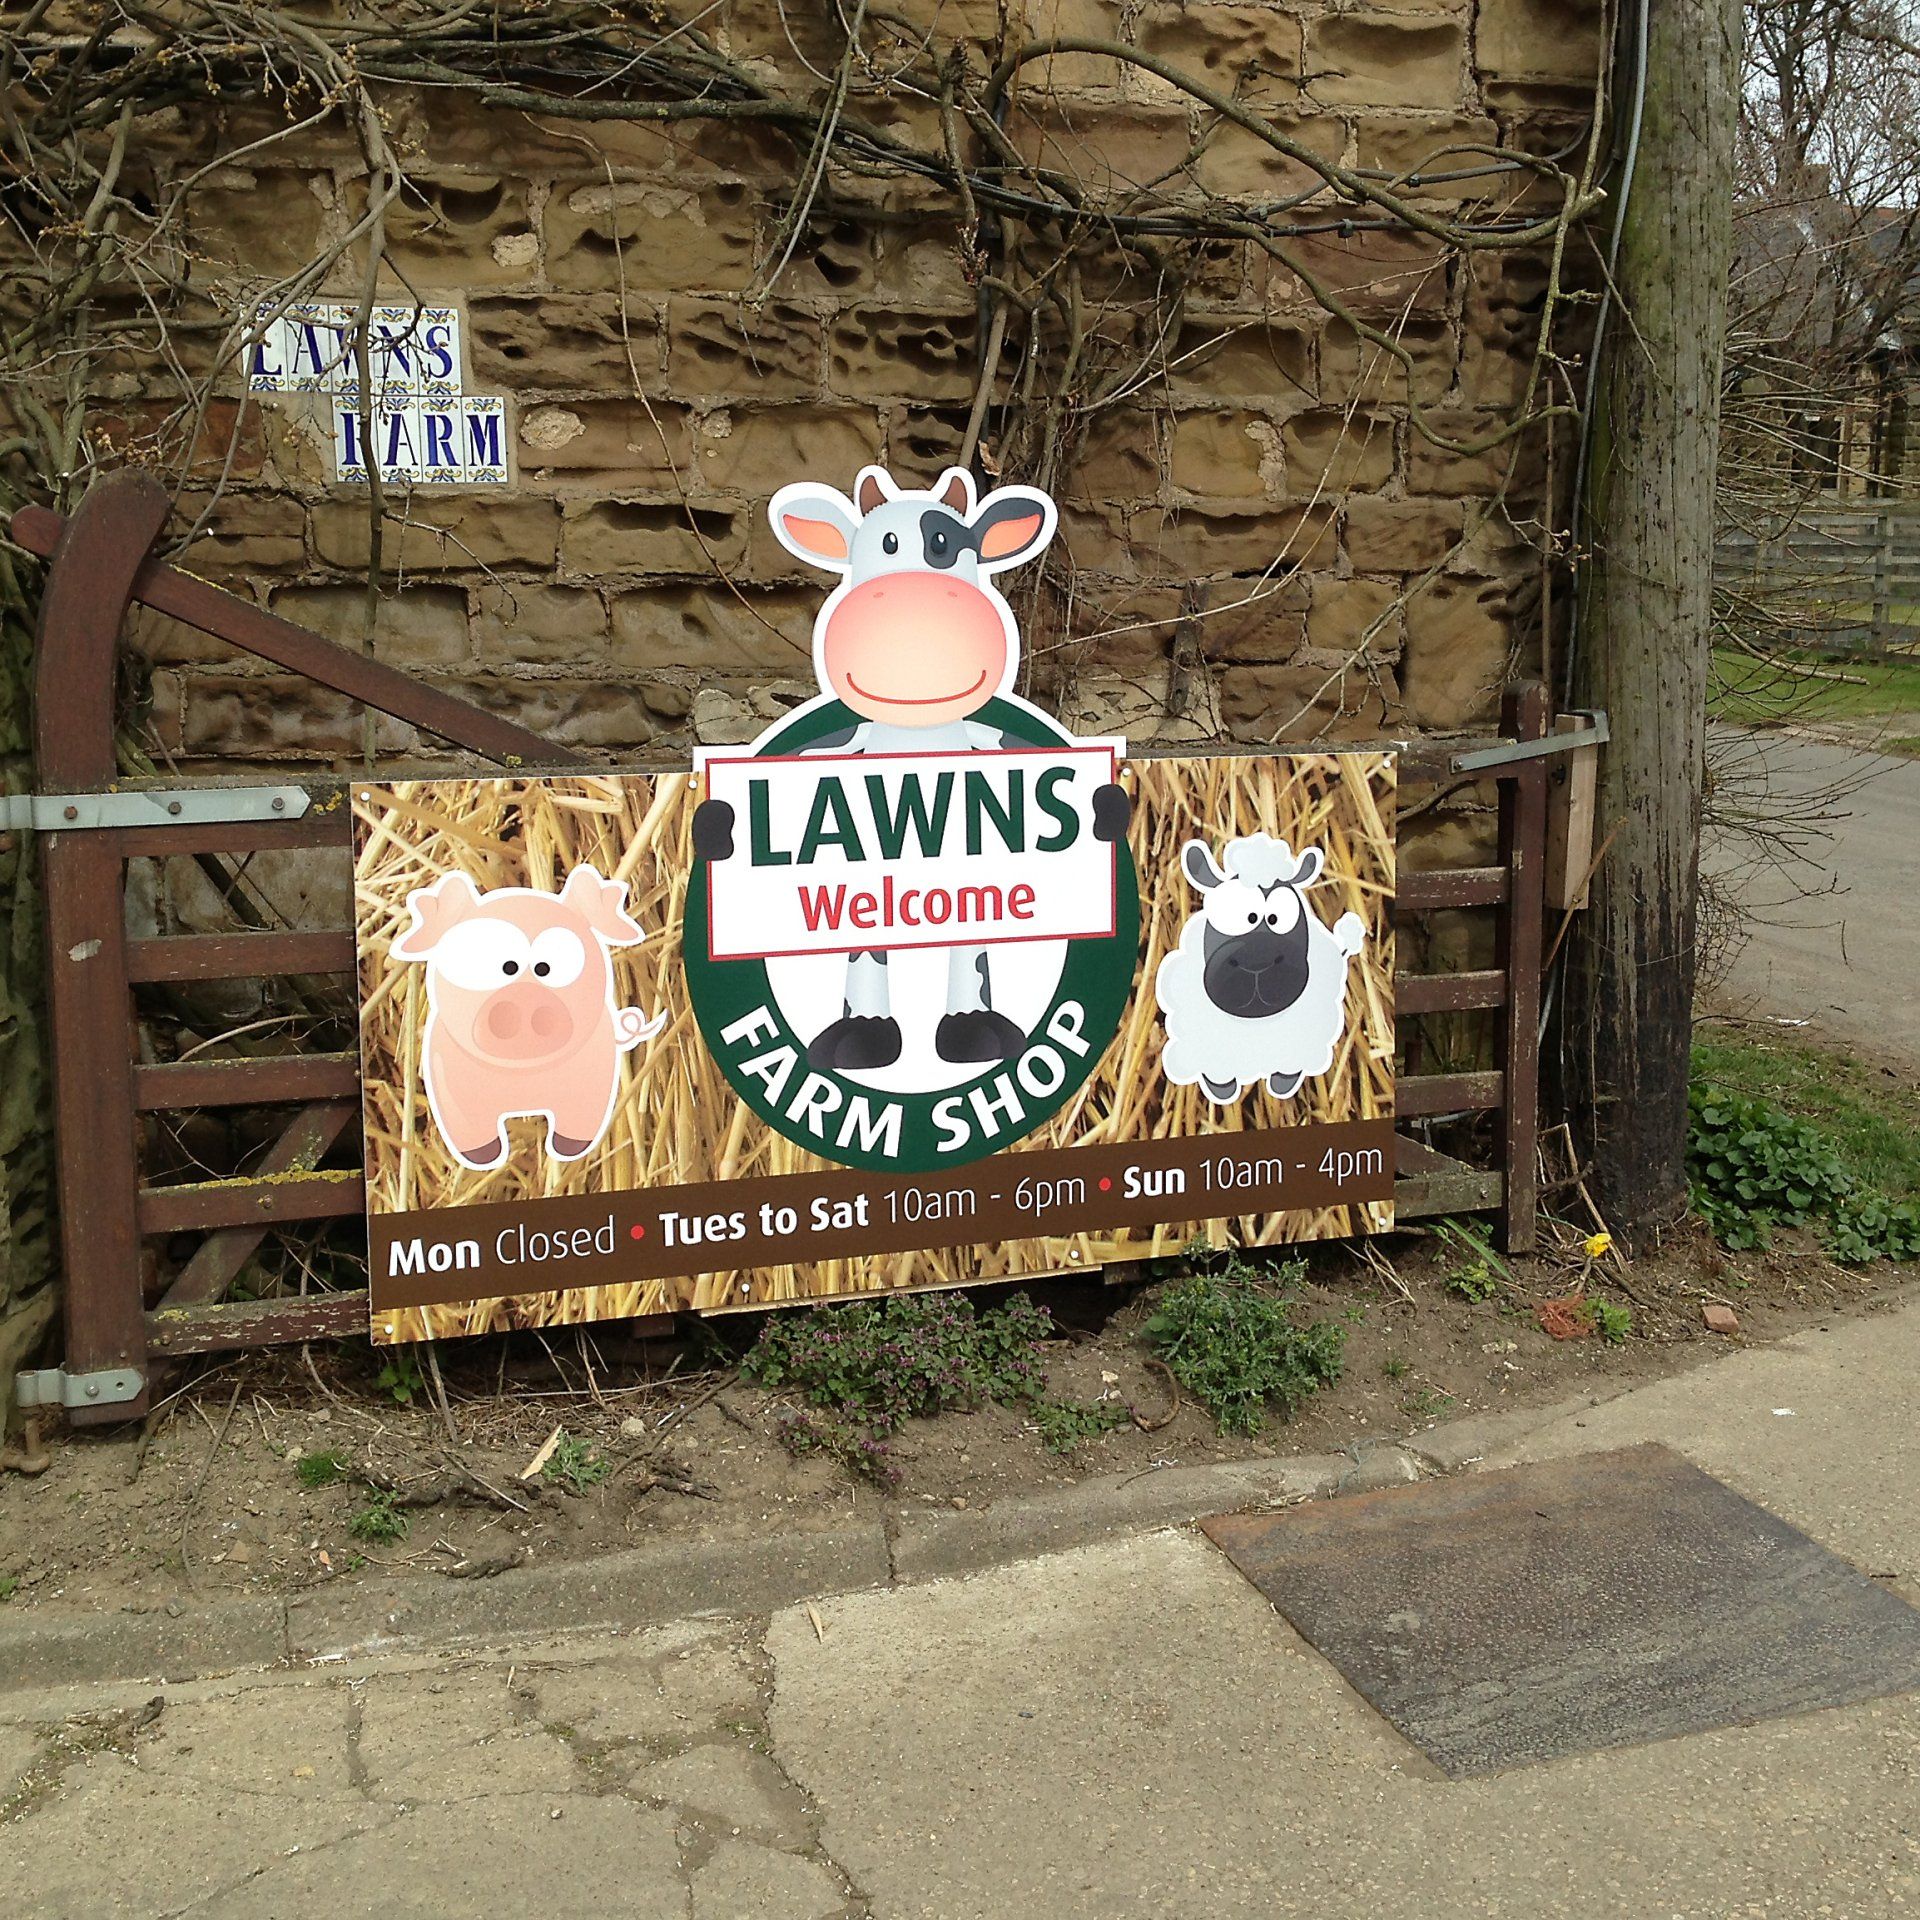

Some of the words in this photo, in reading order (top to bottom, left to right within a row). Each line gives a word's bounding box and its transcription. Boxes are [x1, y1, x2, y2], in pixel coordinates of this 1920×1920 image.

[341, 413, 503, 467] FARM
[748, 766, 1080, 867] LAWNS
[797, 875, 1036, 932] Welcome
[719, 1004, 904, 1159] FARM
[930, 999, 1092, 1153] SHOP
[387, 1237, 481, 1277] Mon
[495, 1214, 616, 1265] Closed
[658, 1211, 747, 1247] Tues
[759, 1202, 798, 1237] to
[809, 1193, 870, 1233] Sat
[882, 1187, 977, 1223] 10am
[1014, 1175, 1086, 1218] 6pm
[1123, 1165, 1186, 1199] Sun
[1199, 1155, 1284, 1191] 10am
[1318, 1146, 1384, 1187] 4pm
